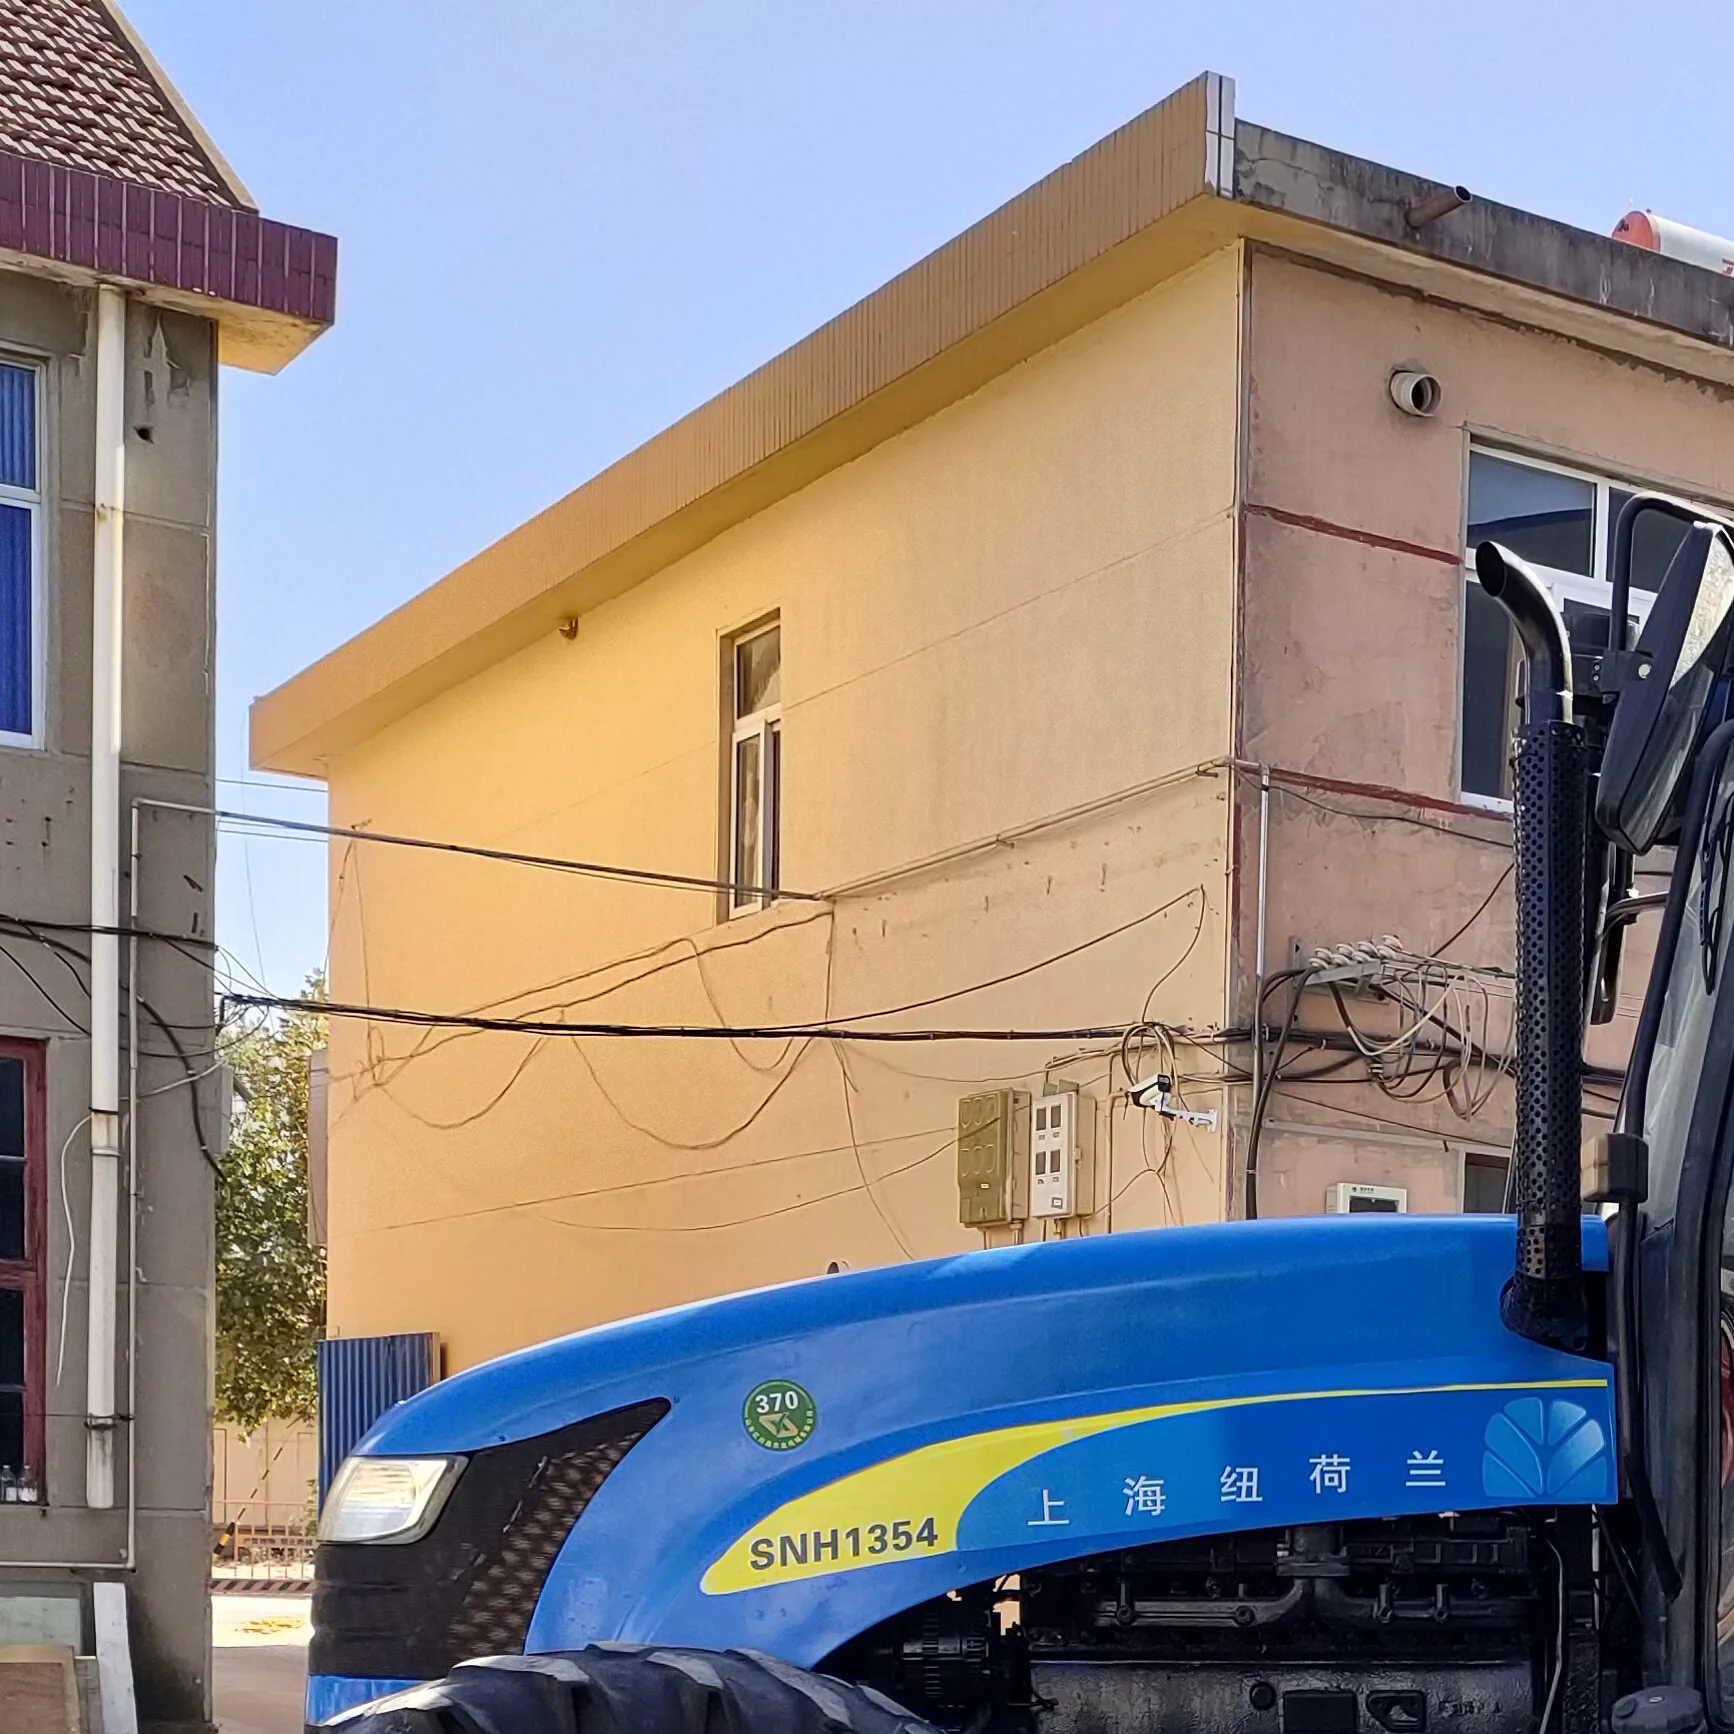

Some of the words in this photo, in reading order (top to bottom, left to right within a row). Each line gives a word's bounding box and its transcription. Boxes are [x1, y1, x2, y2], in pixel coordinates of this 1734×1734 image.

[755, 1391, 798, 1413] 370
[1027, 1450, 1446, 1526] 上海纽荷兰
[749, 1517, 939, 1572] SNH1354
